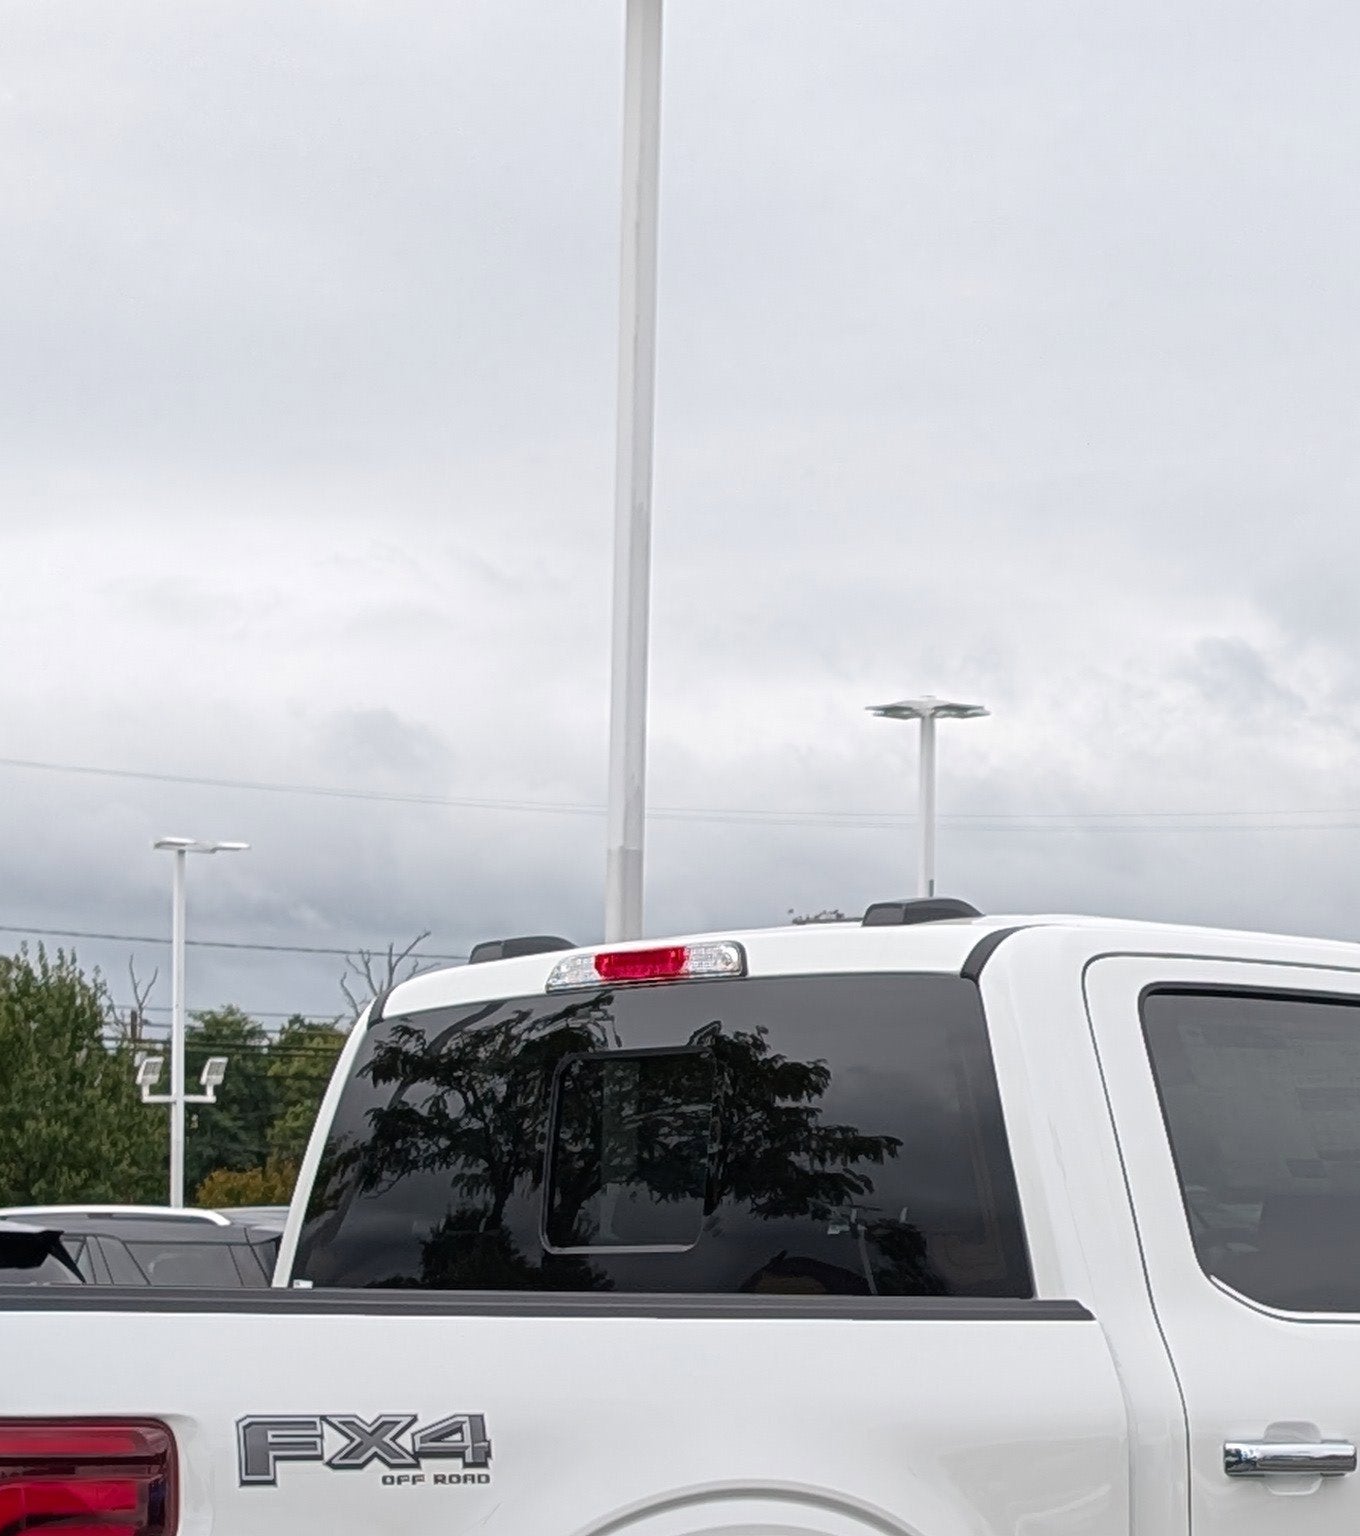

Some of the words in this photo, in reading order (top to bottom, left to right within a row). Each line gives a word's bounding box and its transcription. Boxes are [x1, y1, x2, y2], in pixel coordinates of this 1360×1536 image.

[235, 1413, 493, 1487] FX4
[381, 1473, 425, 1486] OFF
[433, 1473, 492, 1486] ROAD
